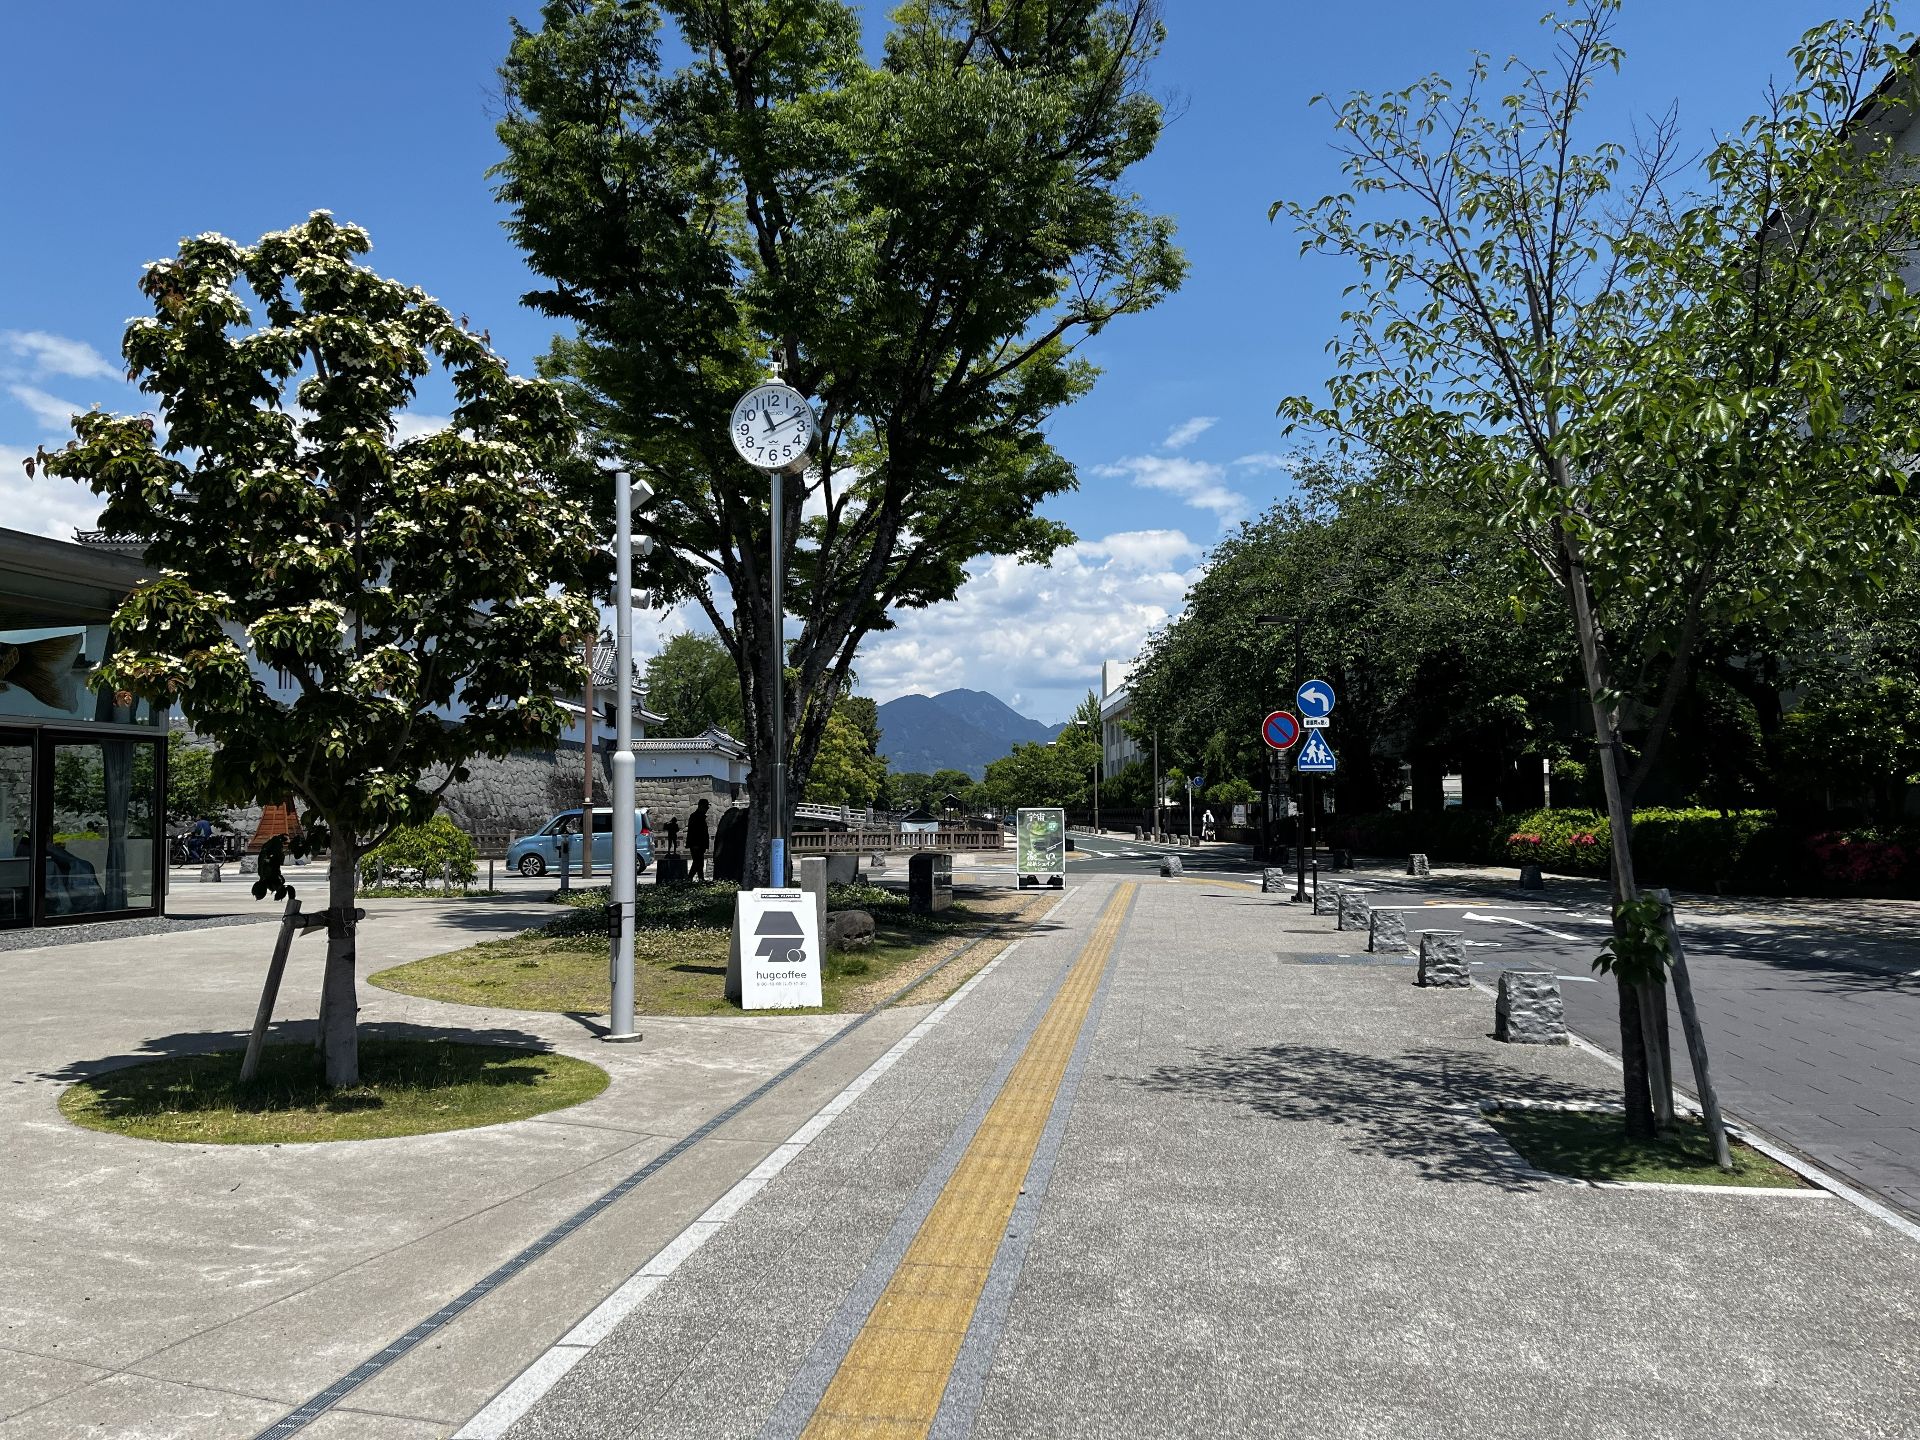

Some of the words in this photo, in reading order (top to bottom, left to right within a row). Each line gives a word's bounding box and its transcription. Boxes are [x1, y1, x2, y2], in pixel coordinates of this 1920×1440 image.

[756, 398, 765, 410] 11
[767, 394, 780, 407] 12
[744, 409, 756, 421] 10
[793, 405, 802, 417] 2
[740, 424, 749, 435] 9
[797, 420, 806, 432] 3
[746, 436, 754, 448] 8
[792, 434, 802, 445] 4
[756, 447, 765, 458] 7
[769, 449, 778, 461] 6
[782, 445, 792, 457] 5
[756, 970, 807, 981] hugcoffee
